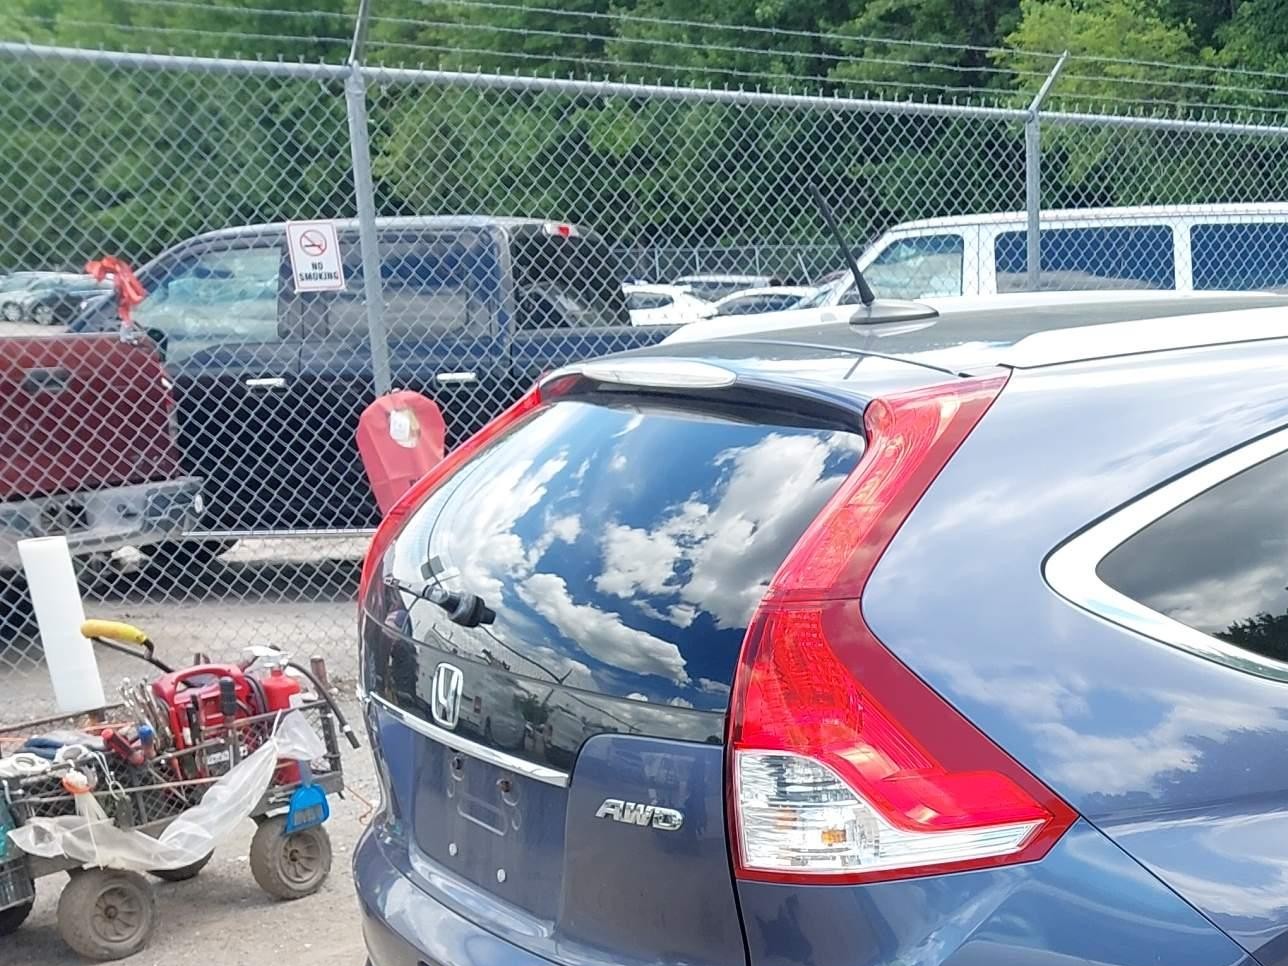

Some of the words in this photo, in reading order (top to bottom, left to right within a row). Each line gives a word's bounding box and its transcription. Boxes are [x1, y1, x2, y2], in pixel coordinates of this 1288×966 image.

[311, 262, 324, 270] NO
[299, 271, 339, 281] SMOKING
[595, 797, 685, 831] AWD
